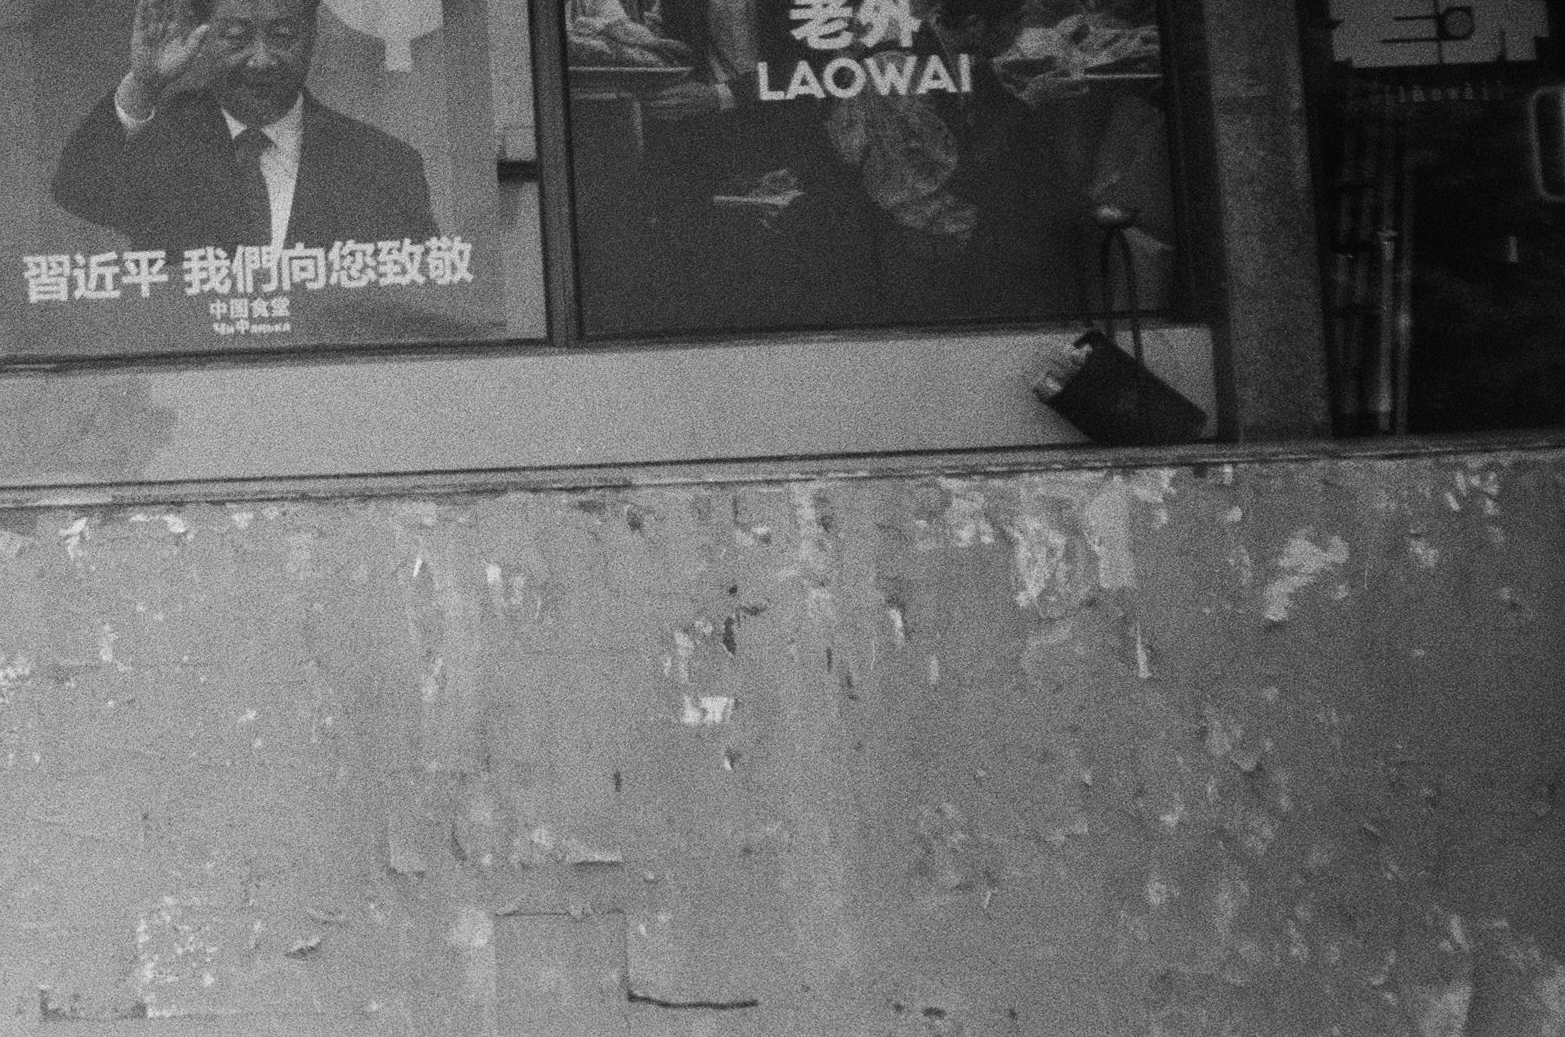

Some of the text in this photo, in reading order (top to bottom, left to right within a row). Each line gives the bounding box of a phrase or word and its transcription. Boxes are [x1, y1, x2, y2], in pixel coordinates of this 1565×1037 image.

[757, 53, 972, 100] LAOWAI
[23, 236, 474, 303] 習近平 我們向您致敬
